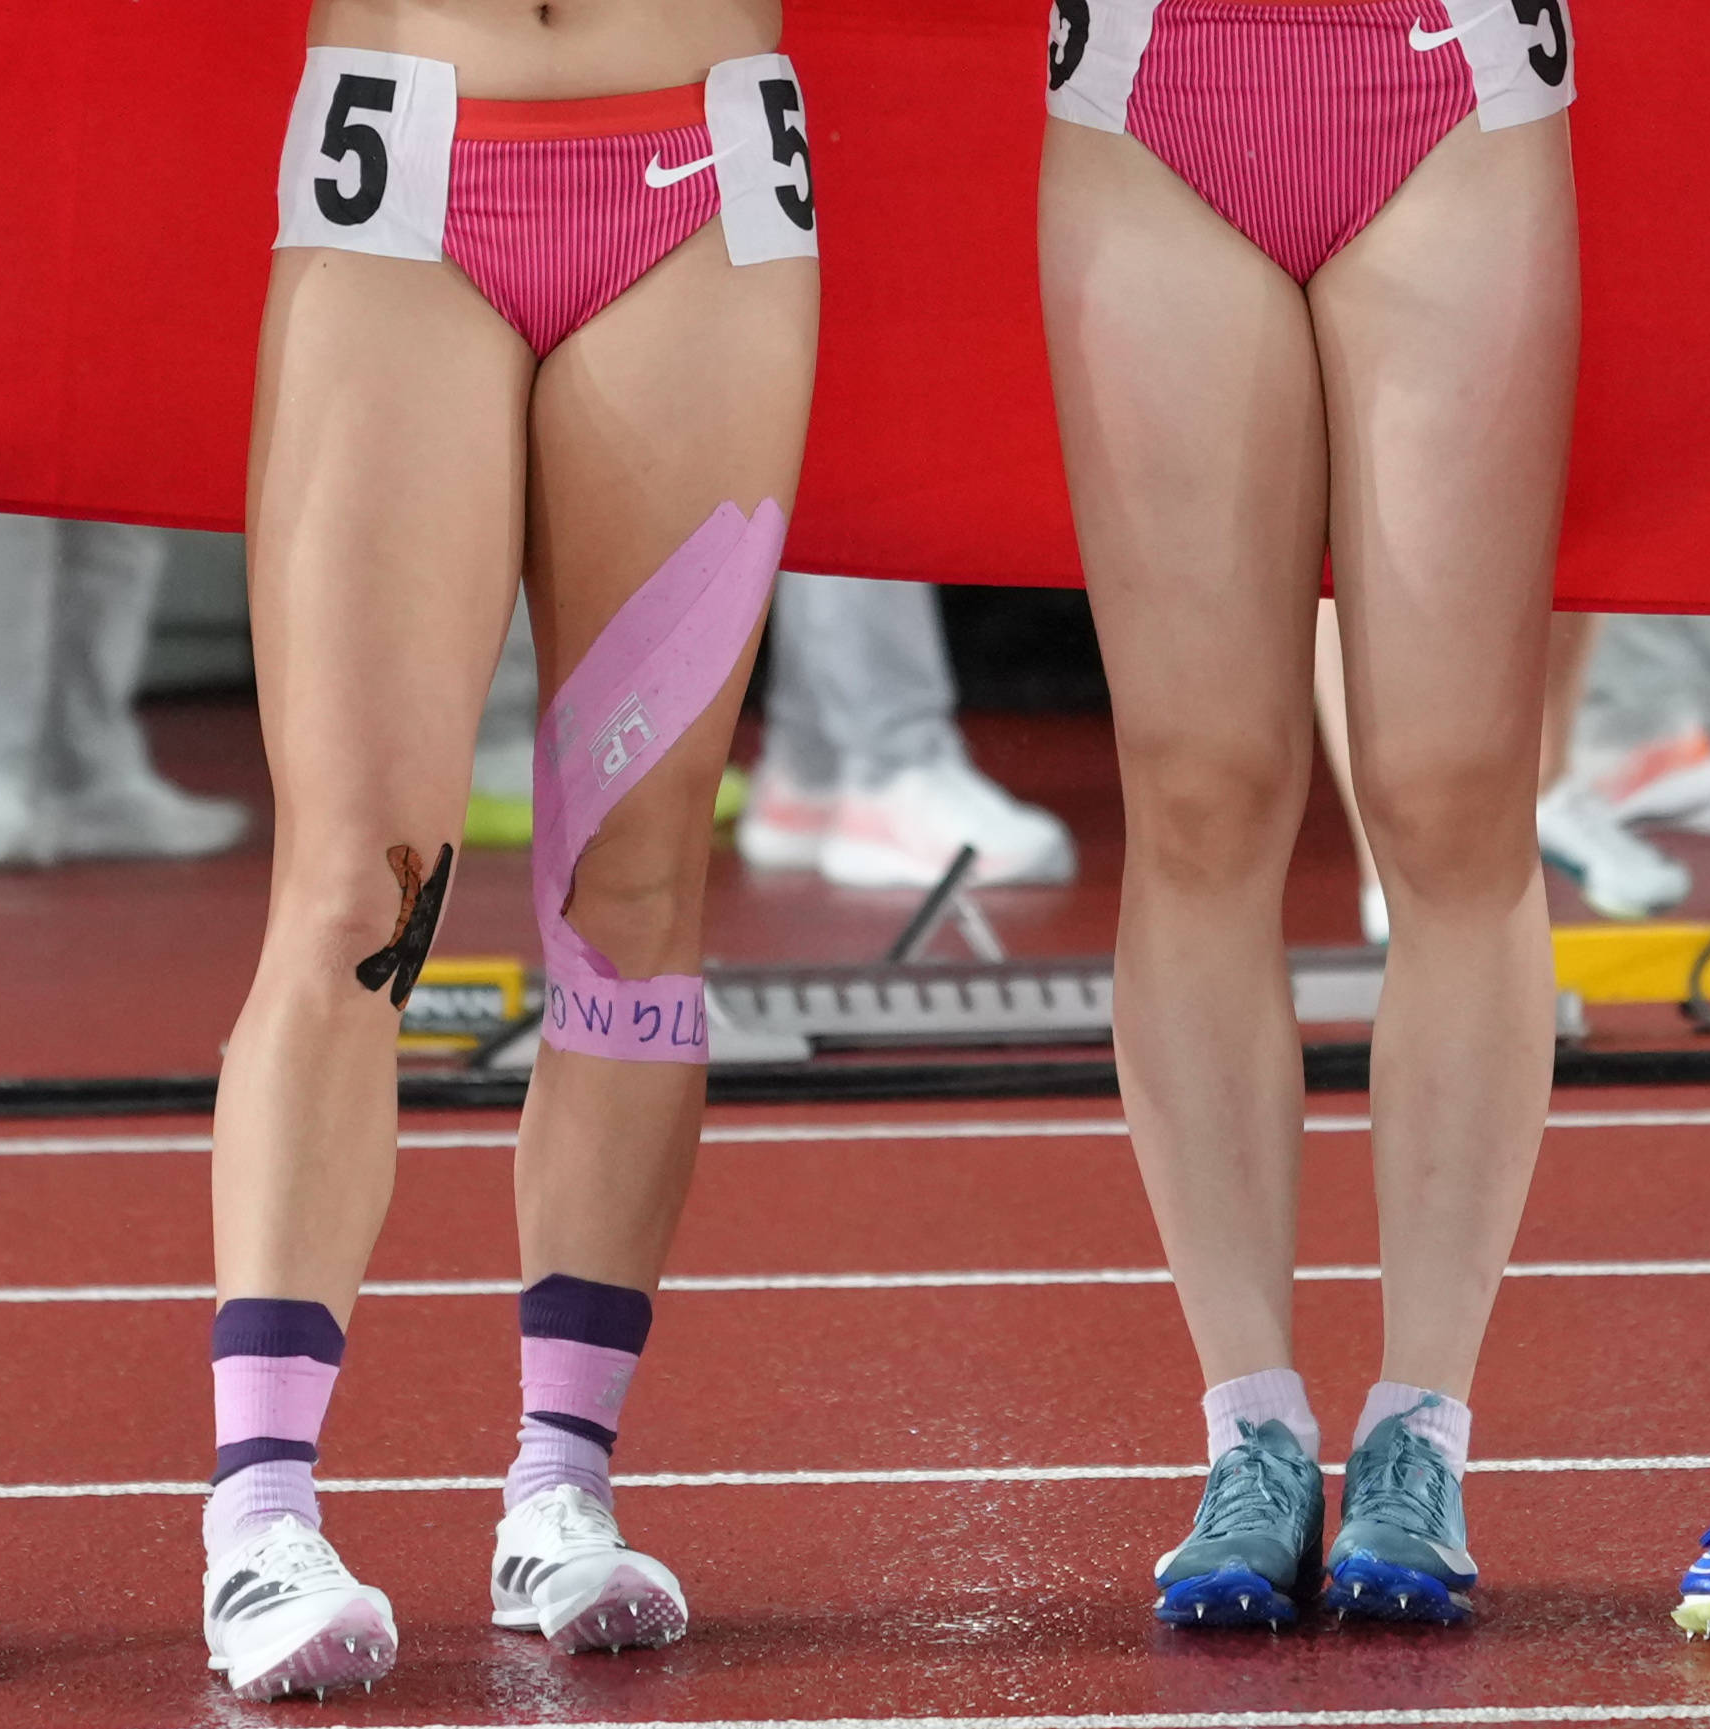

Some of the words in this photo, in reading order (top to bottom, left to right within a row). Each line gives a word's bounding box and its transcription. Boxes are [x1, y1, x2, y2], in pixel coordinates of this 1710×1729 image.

[313, 73, 397, 227] 5
[759, 79, 814, 231] 5
[603, 710, 653, 776] LP
